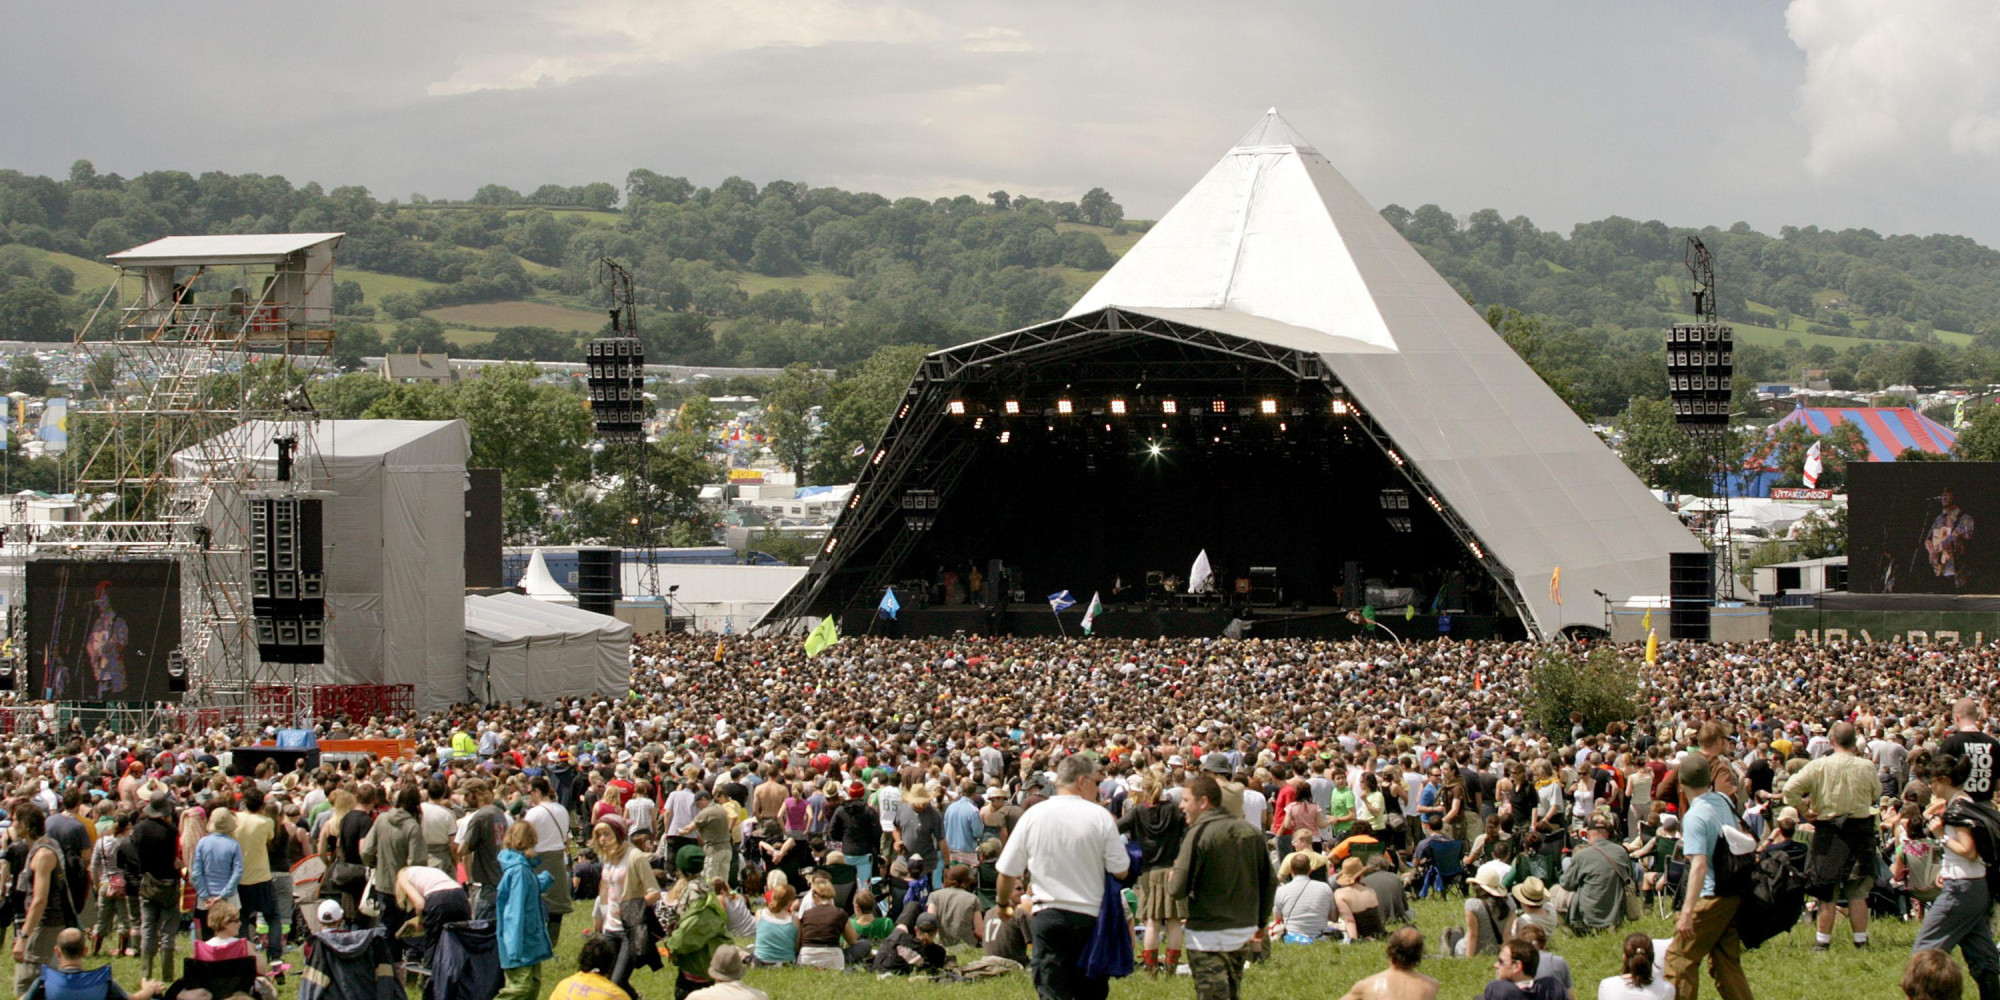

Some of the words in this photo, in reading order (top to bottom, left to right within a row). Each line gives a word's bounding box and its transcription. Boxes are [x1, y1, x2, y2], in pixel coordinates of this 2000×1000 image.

[1963, 742, 1992, 755] HEY
[1969, 768, 1992, 778] ETS
[1963, 776, 1991, 793] GO
[985, 918, 1002, 943] 17
